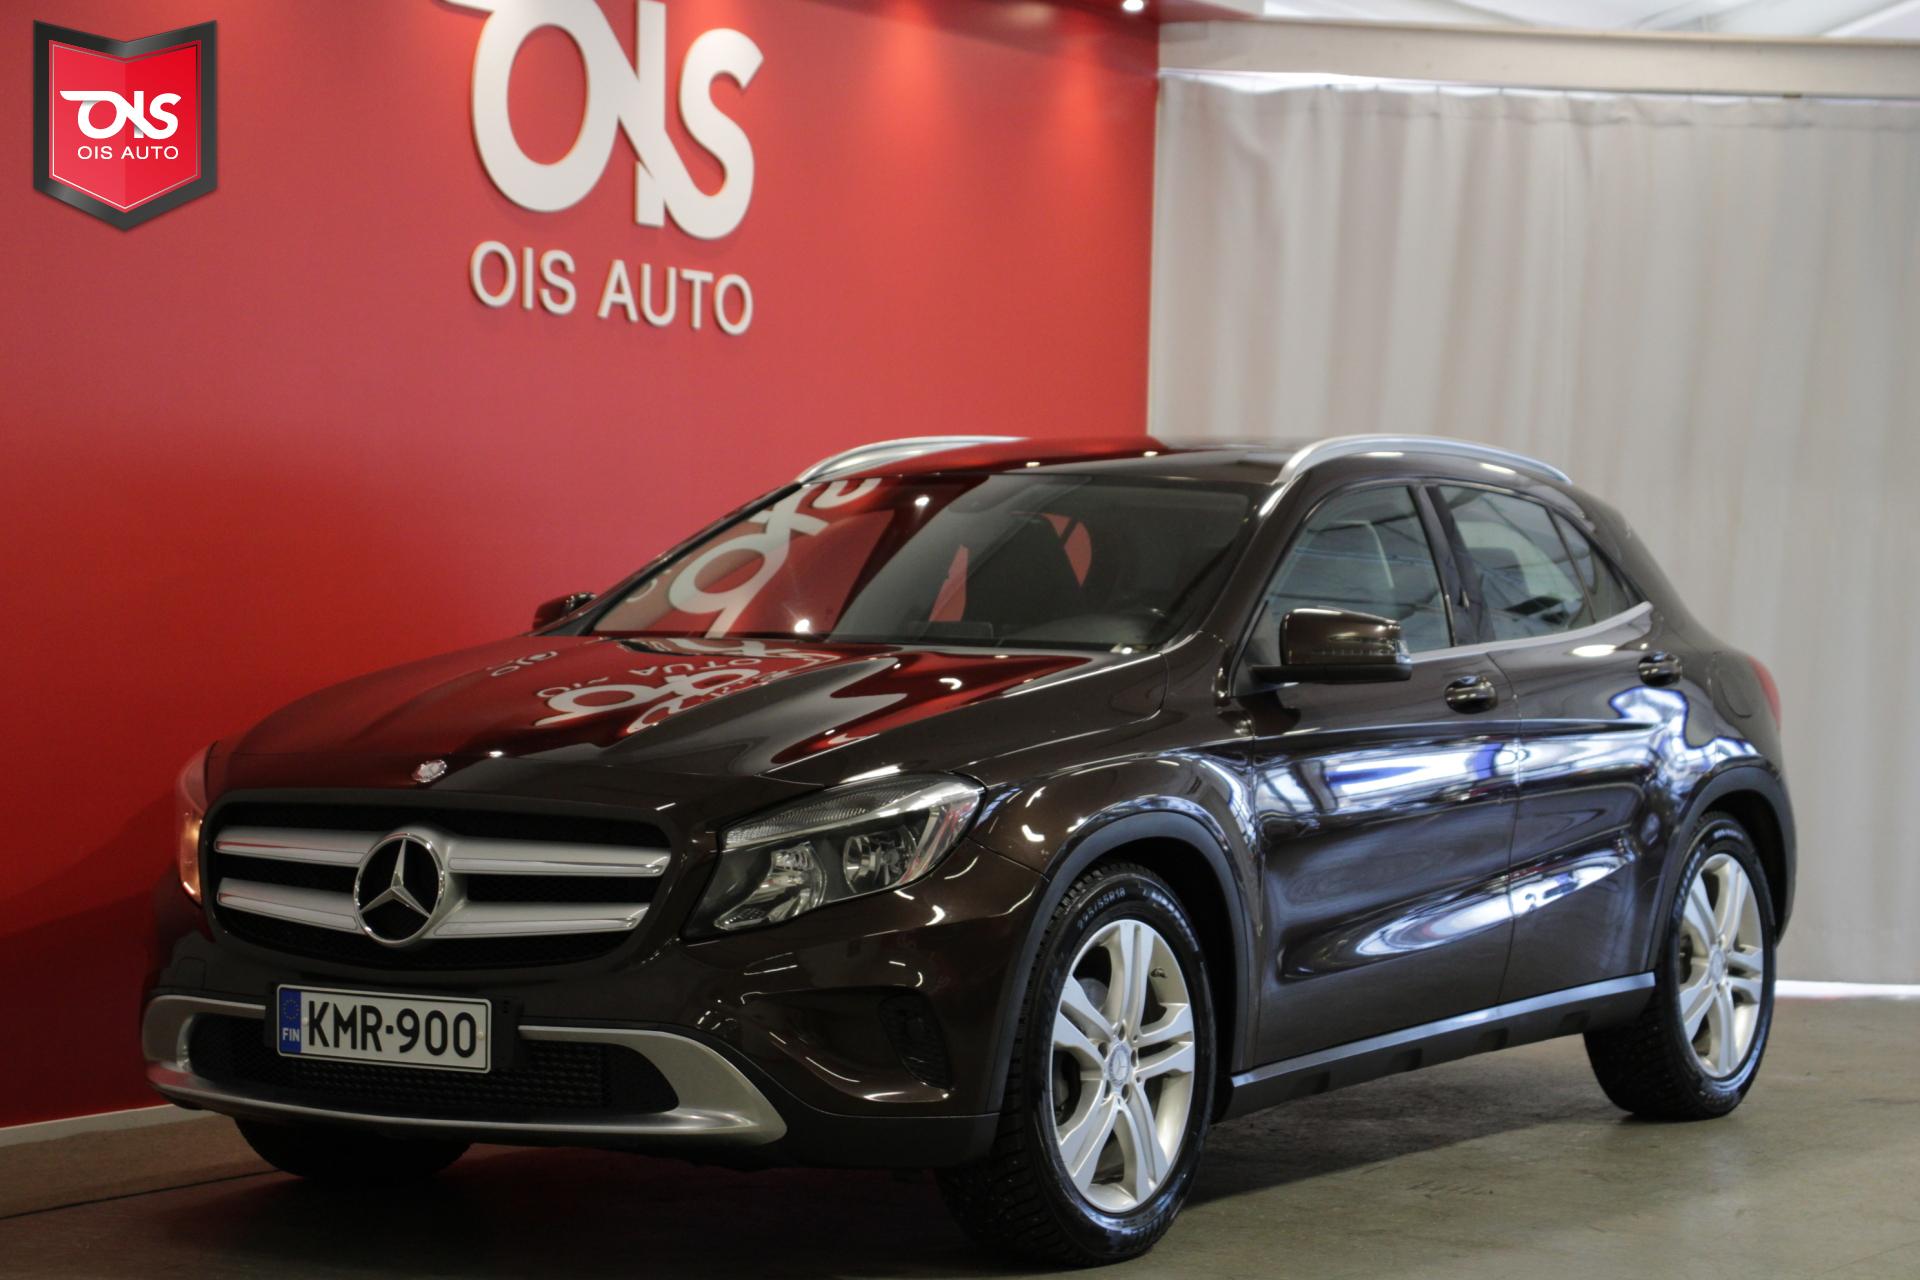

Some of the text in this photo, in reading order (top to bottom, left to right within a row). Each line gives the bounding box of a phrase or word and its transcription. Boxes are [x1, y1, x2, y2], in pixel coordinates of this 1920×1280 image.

[470, 240, 754, 336] OIS AUTO
[282, 1027, 300, 1043] FIN
[308, 1000, 477, 1058] KMR-900
